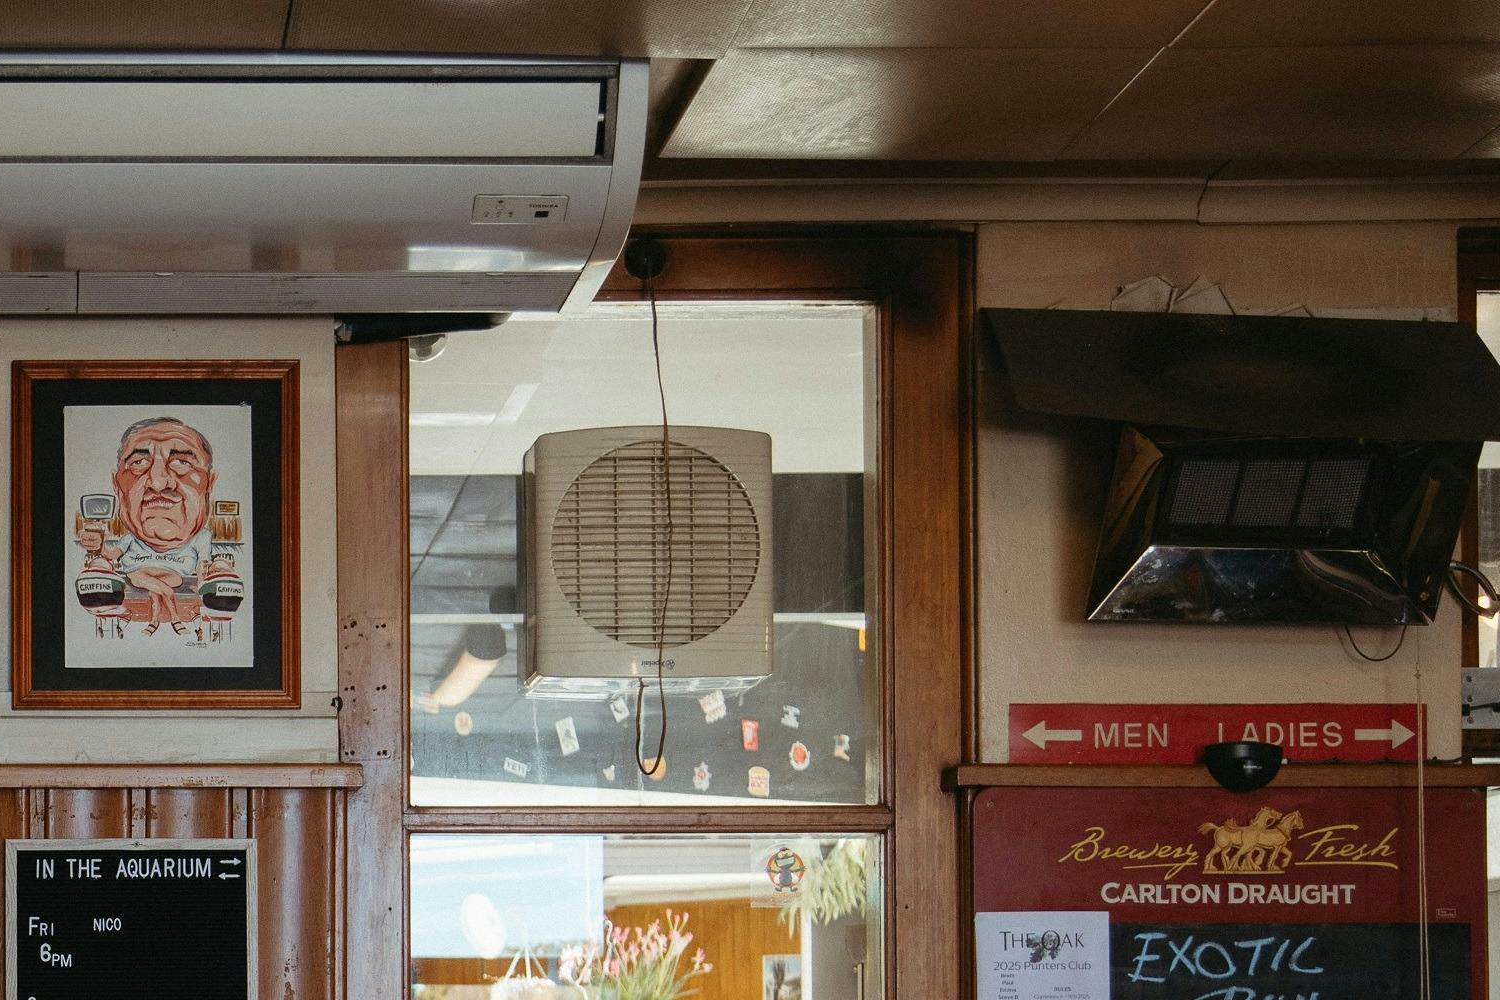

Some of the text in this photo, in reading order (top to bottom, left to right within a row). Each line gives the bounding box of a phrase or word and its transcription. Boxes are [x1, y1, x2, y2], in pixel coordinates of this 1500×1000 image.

[79, 582, 112, 592] GRIFFINS
[1093, 722, 1169, 750] MEN
[1058, 823, 1399, 881] Brewery Fresh
[36, 857, 212, 880] IN THE AQUARIUM
[1100, 881, 1357, 905] CARLTON DRAUGHT
[28, 916, 122, 936] FRI NICO
[1041, 929, 1085, 951] OAK
[40, 942, 72, 967] 6PM
[993, 961, 1092, 971] 2025 Punters Club
[1127, 931, 1324, 983] EXOTIC
